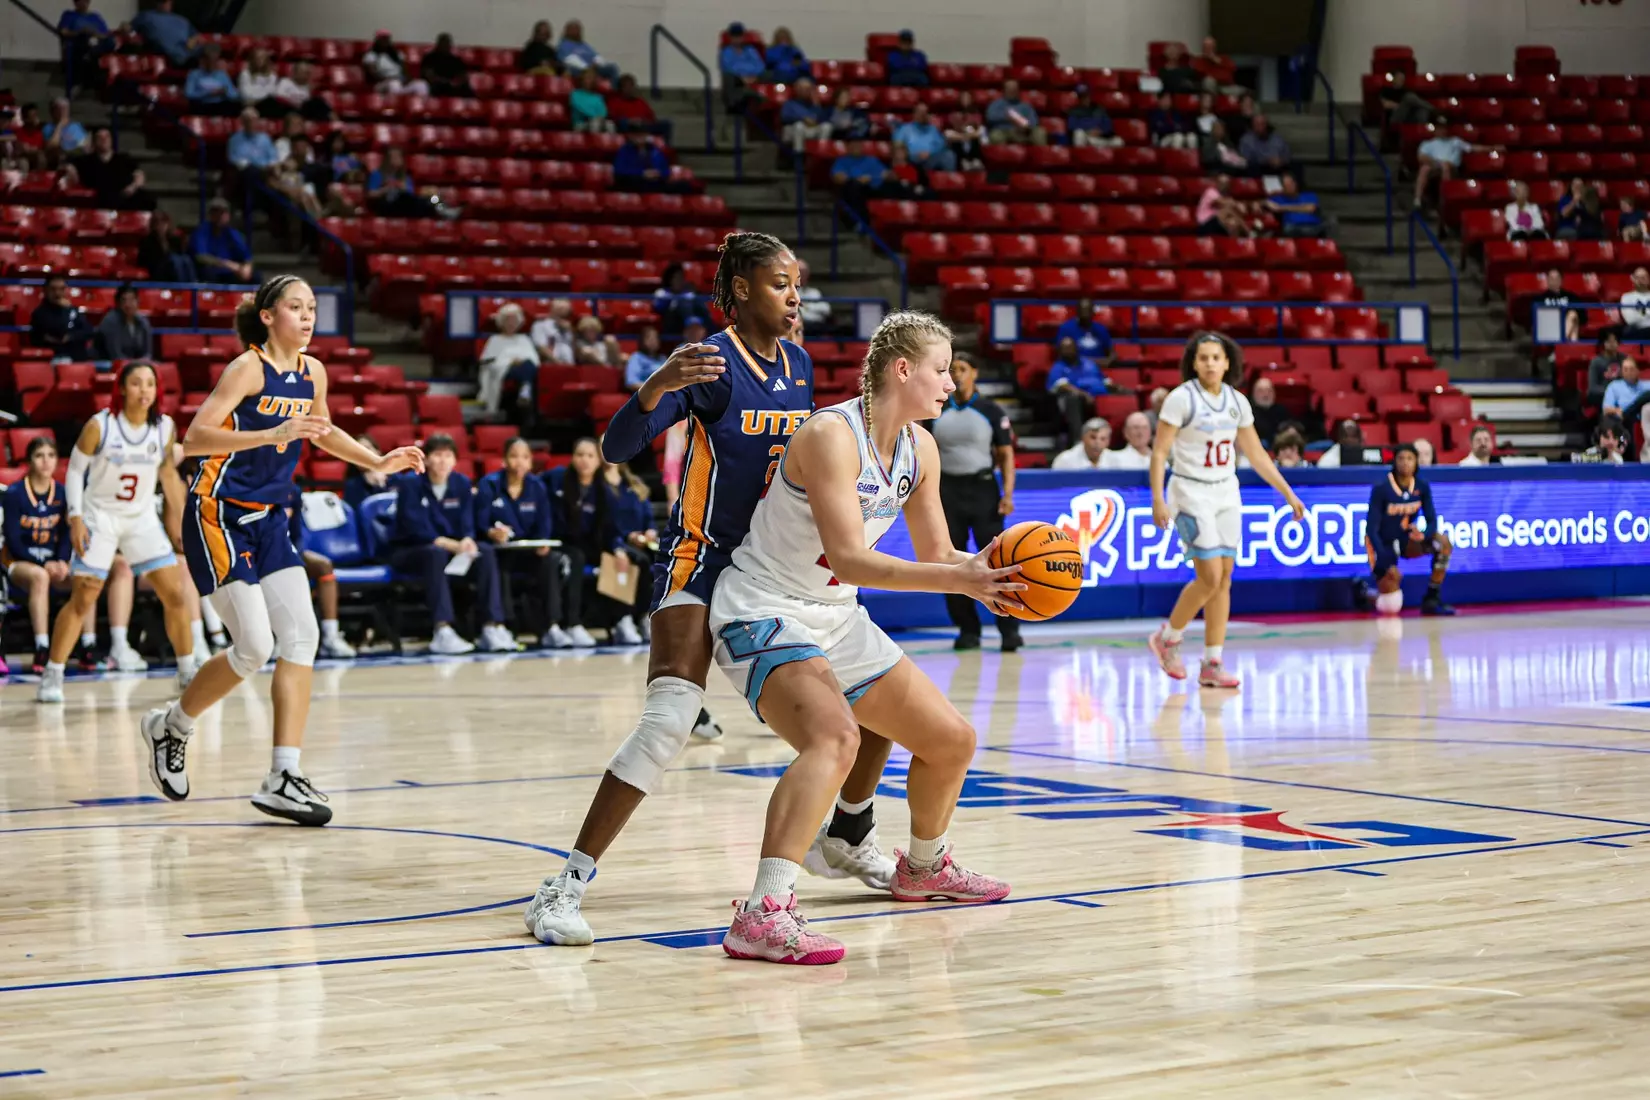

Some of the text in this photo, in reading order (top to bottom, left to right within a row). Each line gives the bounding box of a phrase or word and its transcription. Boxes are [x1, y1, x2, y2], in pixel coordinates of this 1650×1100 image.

[741, 409, 811, 436] UTE
[1204, 440, 1231, 468] 10
[116, 473, 139, 501] 3
[1416, 514, 1489, 550] hen
[1495, 510, 1608, 548] Seconds
[1613, 509, 1650, 544] Co
